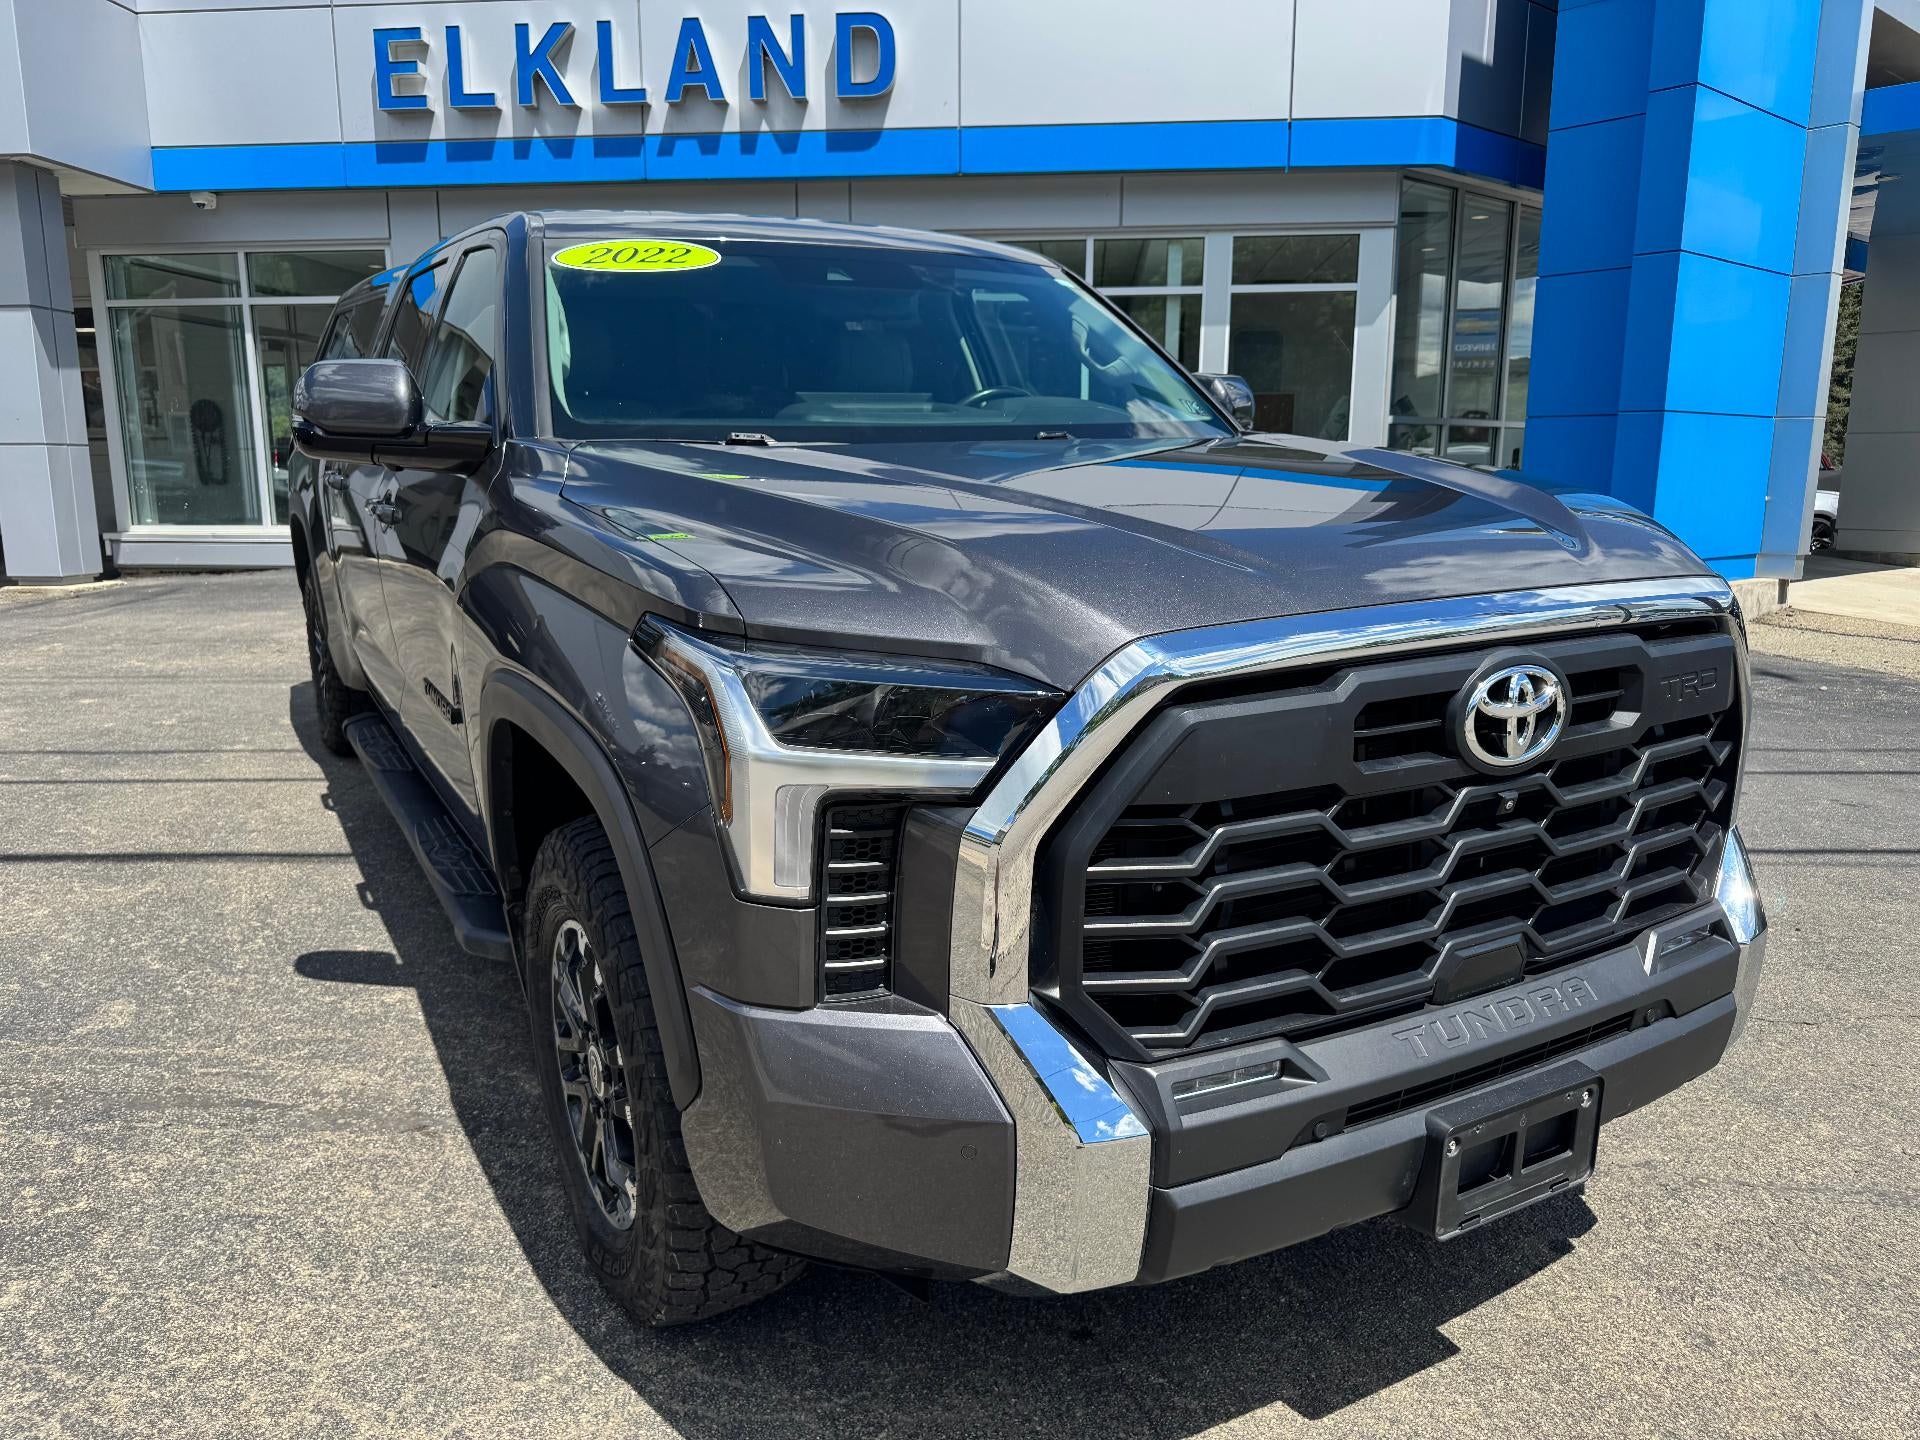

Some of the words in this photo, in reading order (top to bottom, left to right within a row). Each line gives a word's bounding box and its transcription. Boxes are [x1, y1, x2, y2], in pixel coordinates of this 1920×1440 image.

[373, 12, 897, 111] ELKLAND
[582, 247, 692, 264] 2022
[1660, 668, 1718, 702] TRD
[1391, 976, 1599, 1058] TUNDRA
